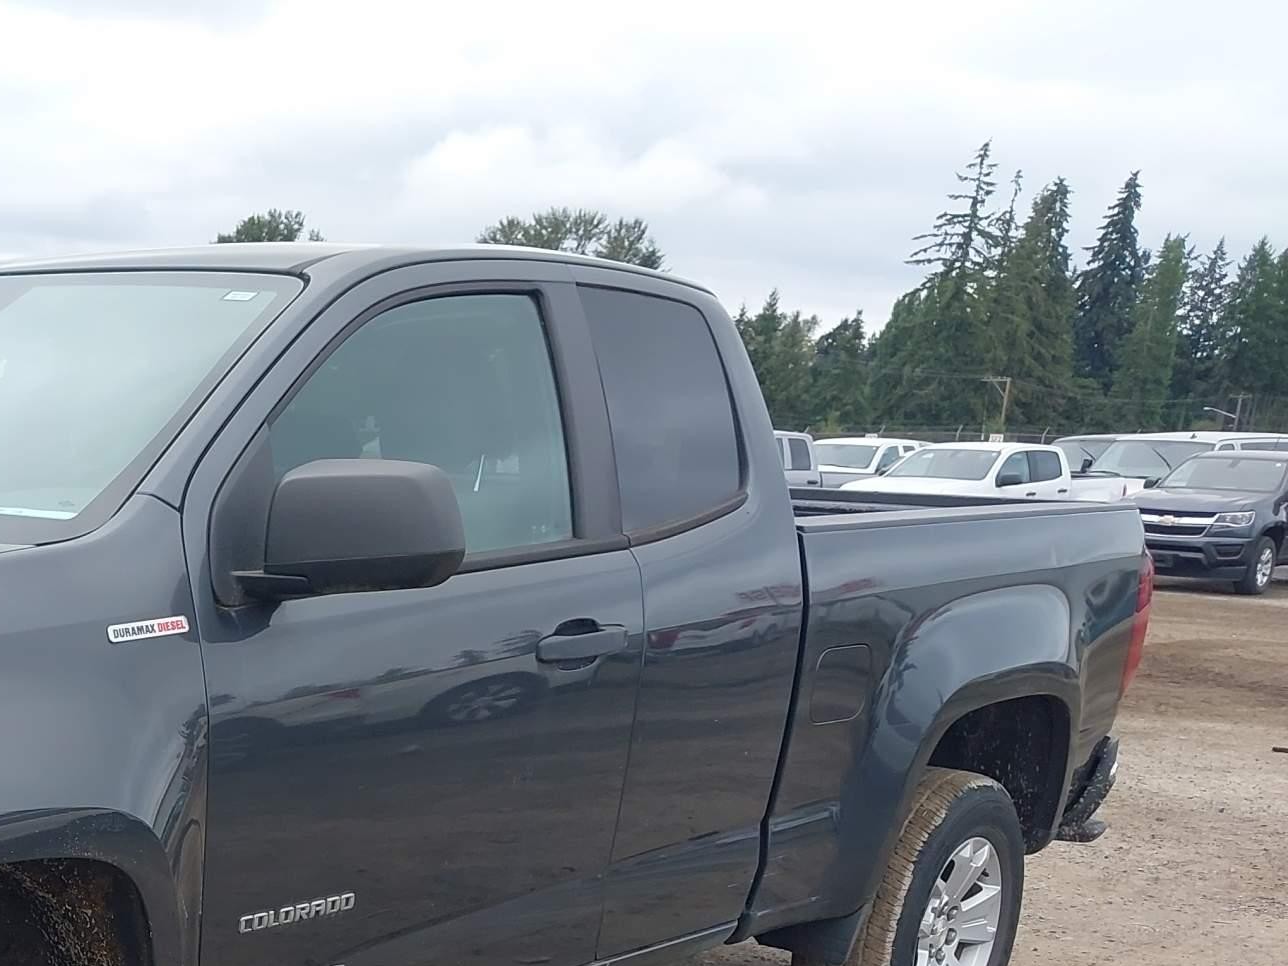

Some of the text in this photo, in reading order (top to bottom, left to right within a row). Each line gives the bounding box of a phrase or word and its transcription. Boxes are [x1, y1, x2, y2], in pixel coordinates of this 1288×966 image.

[112, 619, 186, 639] DURAMAX DIESEL
[239, 892, 356, 934] COLORADO
